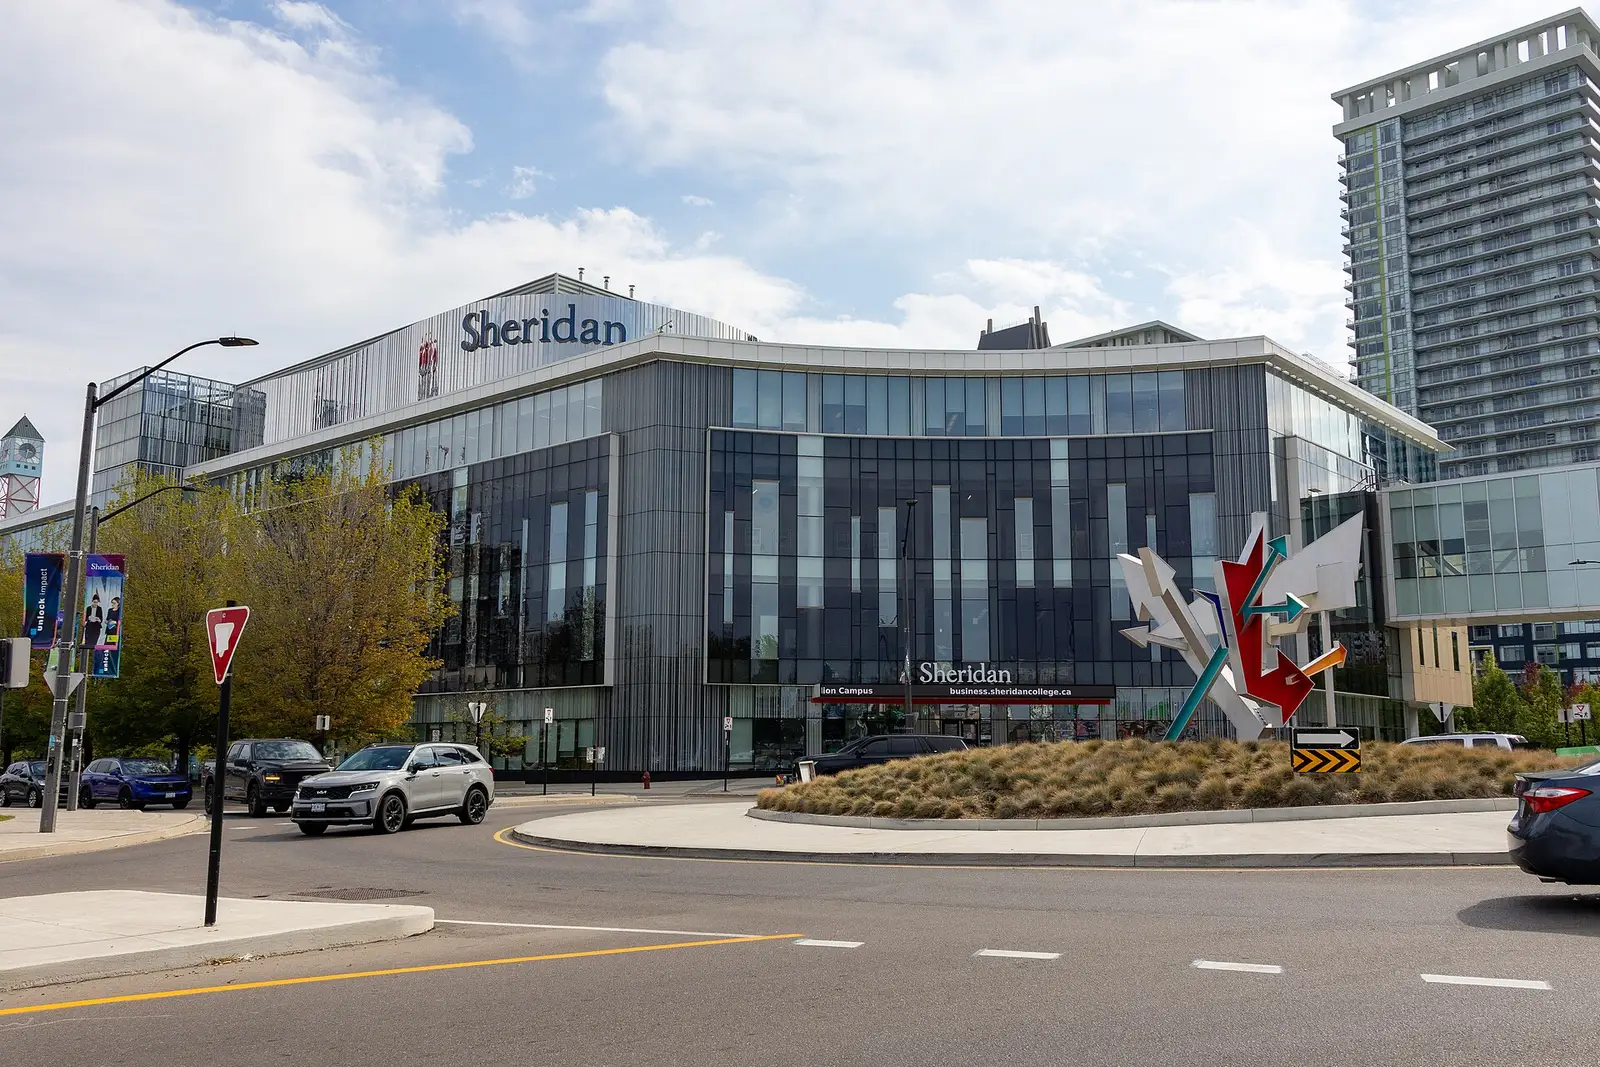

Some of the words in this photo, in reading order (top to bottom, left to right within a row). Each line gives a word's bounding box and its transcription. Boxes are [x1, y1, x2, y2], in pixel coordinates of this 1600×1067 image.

[461, 304, 627, 352] Sheridan
[91, 563, 119, 571] Sheridan
[39, 568, 48, 596] impact
[37, 598, 45, 631] unlock
[920, 662, 1012, 683] Sheridan
[838, 687, 873, 695] Campus
[949, 687, 1072, 697] business.sheridancollege.ca
